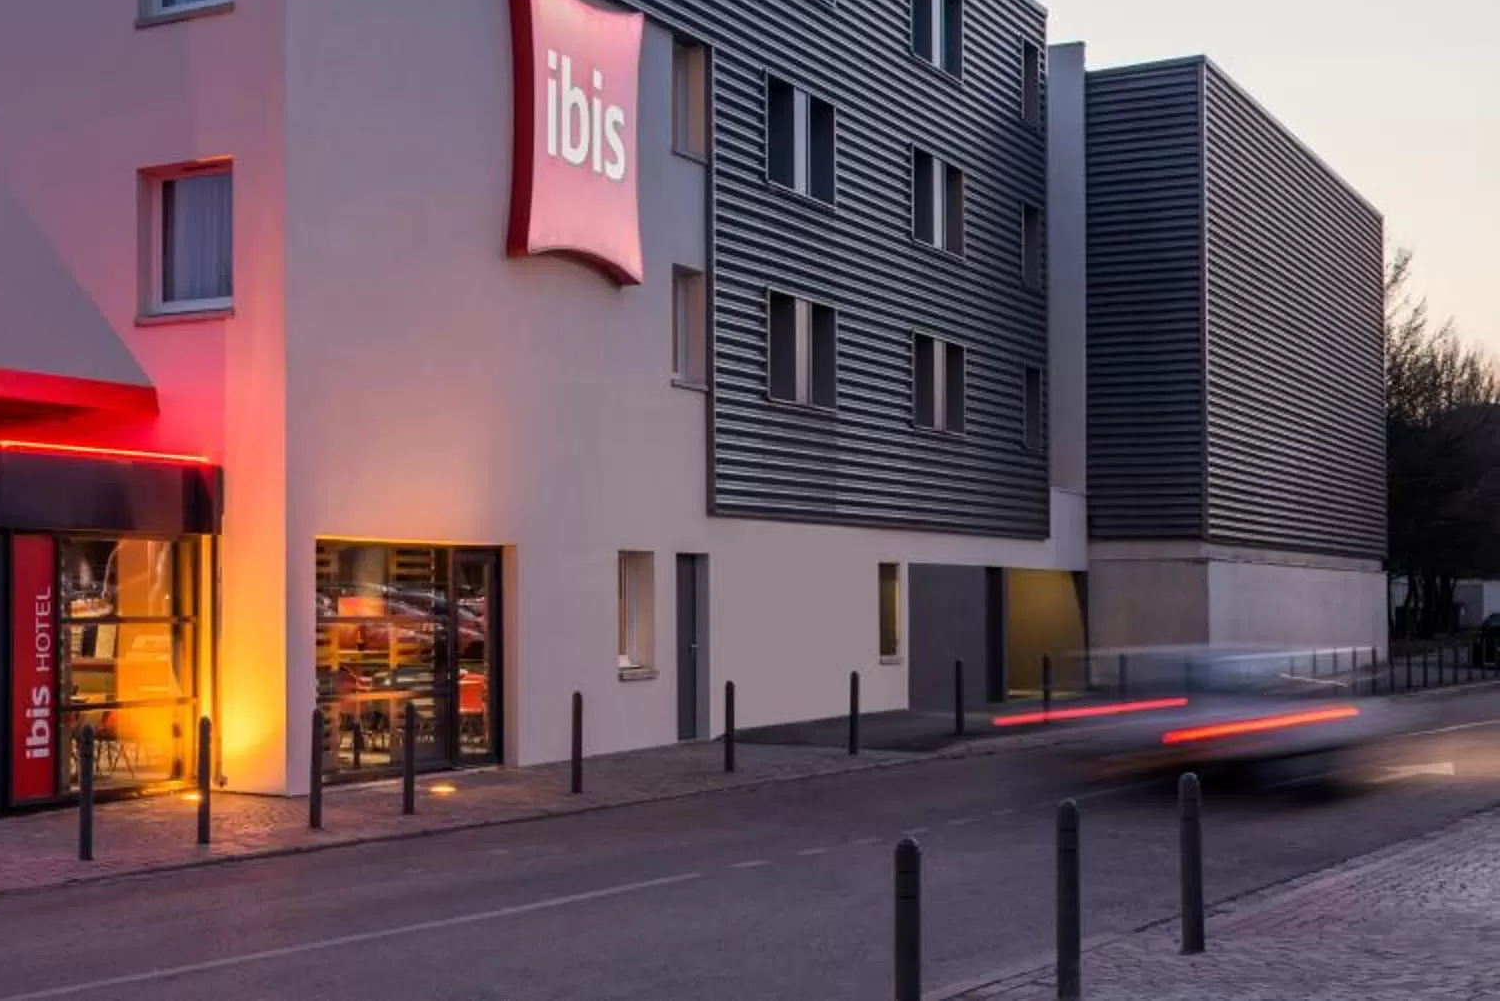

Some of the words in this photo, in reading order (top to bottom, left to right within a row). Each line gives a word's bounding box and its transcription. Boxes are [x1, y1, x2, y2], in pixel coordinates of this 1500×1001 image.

[547, 48, 626, 182] ibis
[35, 586, 51, 672] HOTEL
[26, 685, 50, 759] ibis
